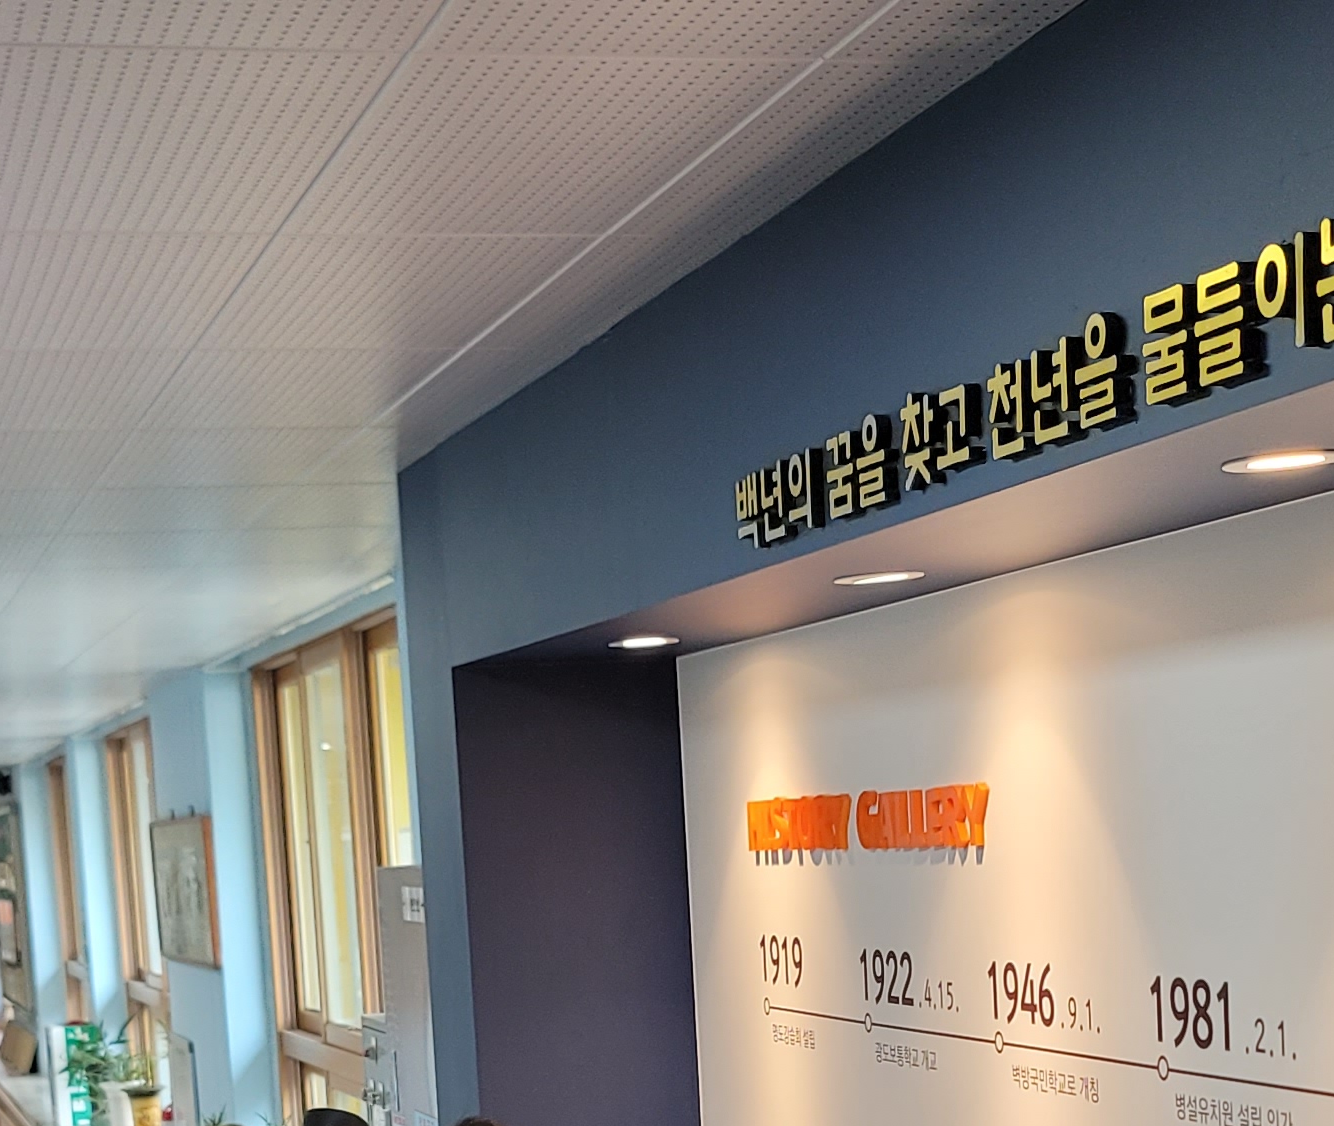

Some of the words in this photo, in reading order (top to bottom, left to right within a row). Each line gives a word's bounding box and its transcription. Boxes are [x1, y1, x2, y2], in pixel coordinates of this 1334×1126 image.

[735, 447, 813, 549] 백년의
[825, 413, 887, 520] 꿈을
[900, 383, 970, 492] 찾고
[986, 312, 1118, 461] 천년을
[856, 782, 990, 853] GALLERY
[759, 933, 804, 988] 1919
[874, 1042, 920, 1069] 광도보통학교
[921, 1049, 938, 1072] 개교
[1012, 1064, 1077, 1097] 벽방국민학교로
[1079, 1076, 1100, 1104] 개칭
